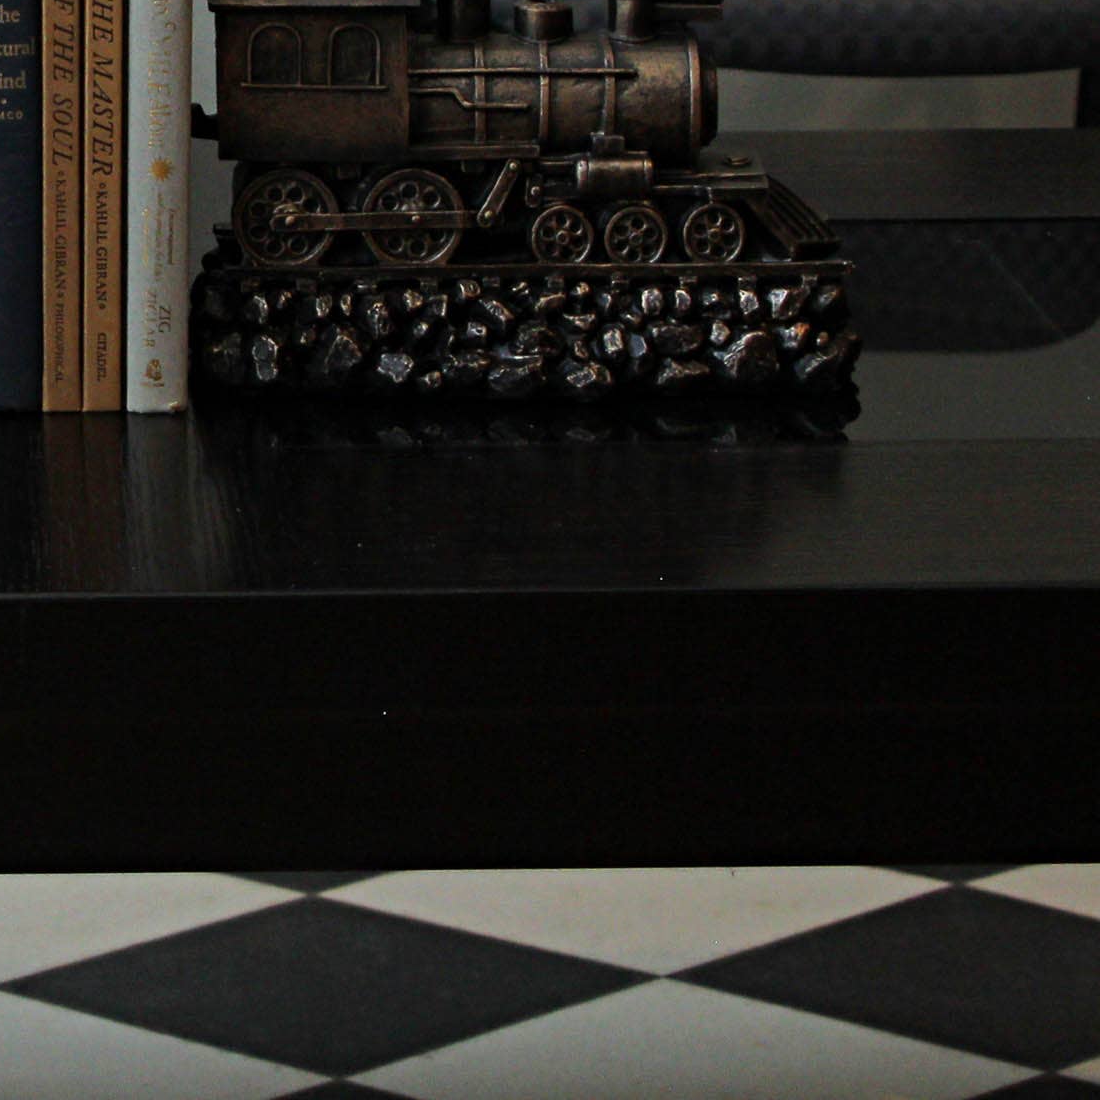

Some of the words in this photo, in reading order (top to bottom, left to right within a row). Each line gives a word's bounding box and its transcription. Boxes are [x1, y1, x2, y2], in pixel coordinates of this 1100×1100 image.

[53, 23, 75, 83] THE
[52, 93, 74, 166] SOUL
[92, 52, 114, 176] MASTER
[55, 179, 67, 228] KAHLIL
[95, 190, 108, 240] KAHLIL
[55, 235, 67, 290] GIBRAN
[95, 246, 108, 303] GIBRAN
[158, 305, 171, 334] ZIG
[96, 333, 107, 382] CITADEL
